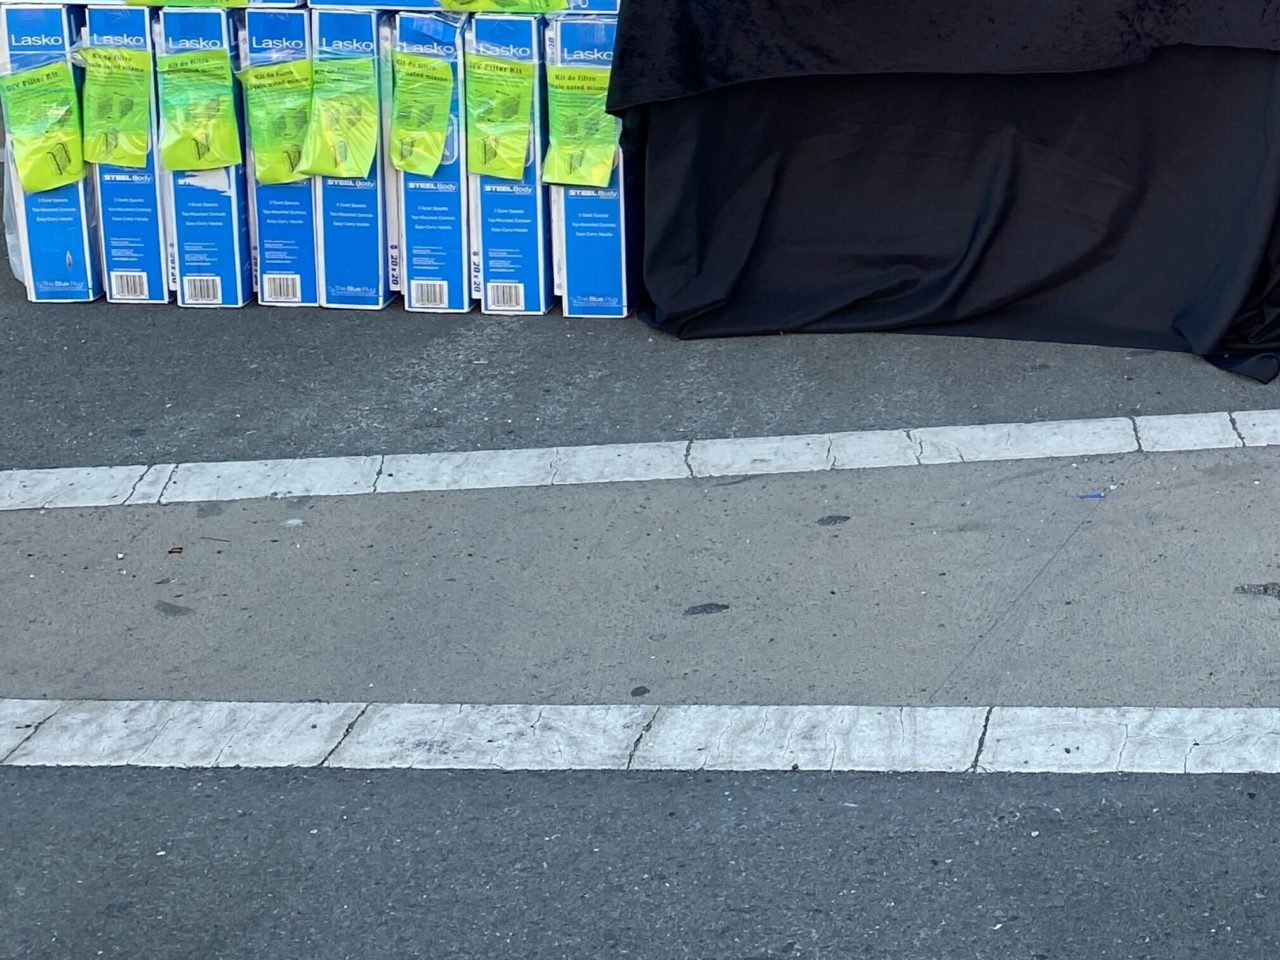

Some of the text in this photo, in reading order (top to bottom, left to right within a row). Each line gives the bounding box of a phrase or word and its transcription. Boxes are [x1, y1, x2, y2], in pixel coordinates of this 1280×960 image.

[11, 33, 62, 47] Lasko
[93, 33, 145, 47] Lasko
[168, 36, 221, 49] Lasko
[252, 36, 304, 49] Lasko
[322, 37, 374, 51] Lasko
[402, 41, 455, 54] Lasko
[480, 43, 531, 57] Lasko
[510, 66, 523, 74] Kit
[391, 274, 399, 286] 20
[474, 281, 481, 293] 20
